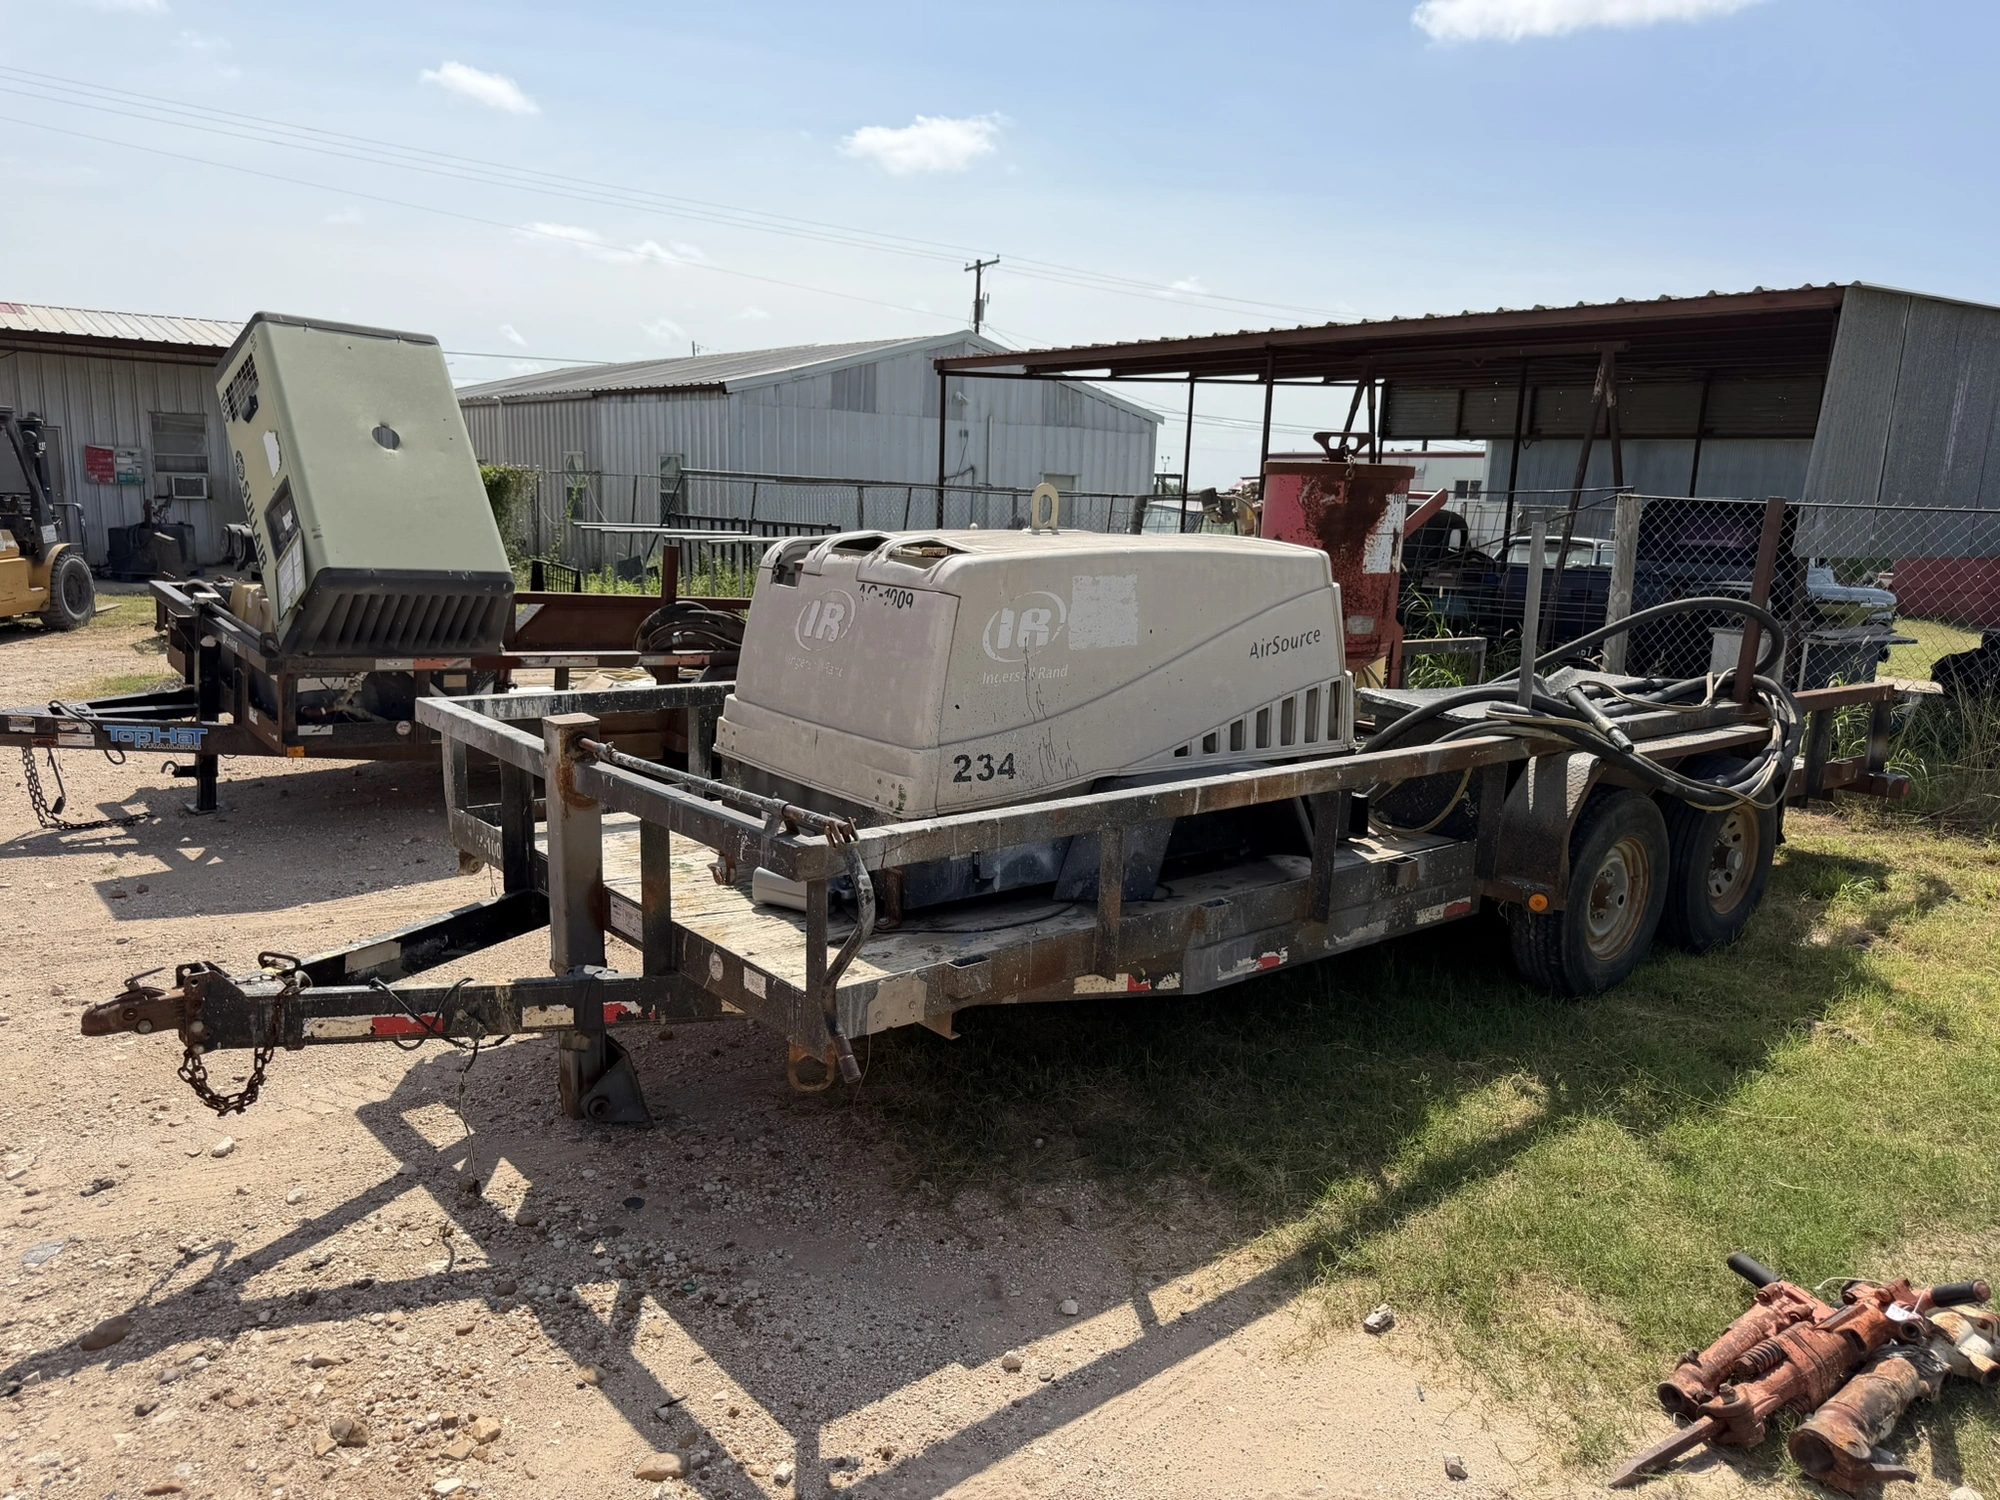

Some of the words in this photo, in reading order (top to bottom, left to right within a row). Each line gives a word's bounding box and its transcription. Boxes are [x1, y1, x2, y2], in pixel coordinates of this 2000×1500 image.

[242, 480, 268, 570] SULLAIR
[803, 600, 846, 642] IR
[997, 607, 1052, 650] IR
[1249, 629, 1321, 659] AirSource
[1038, 664, 1069, 680] Rand
[953, 752, 1016, 783] 234
